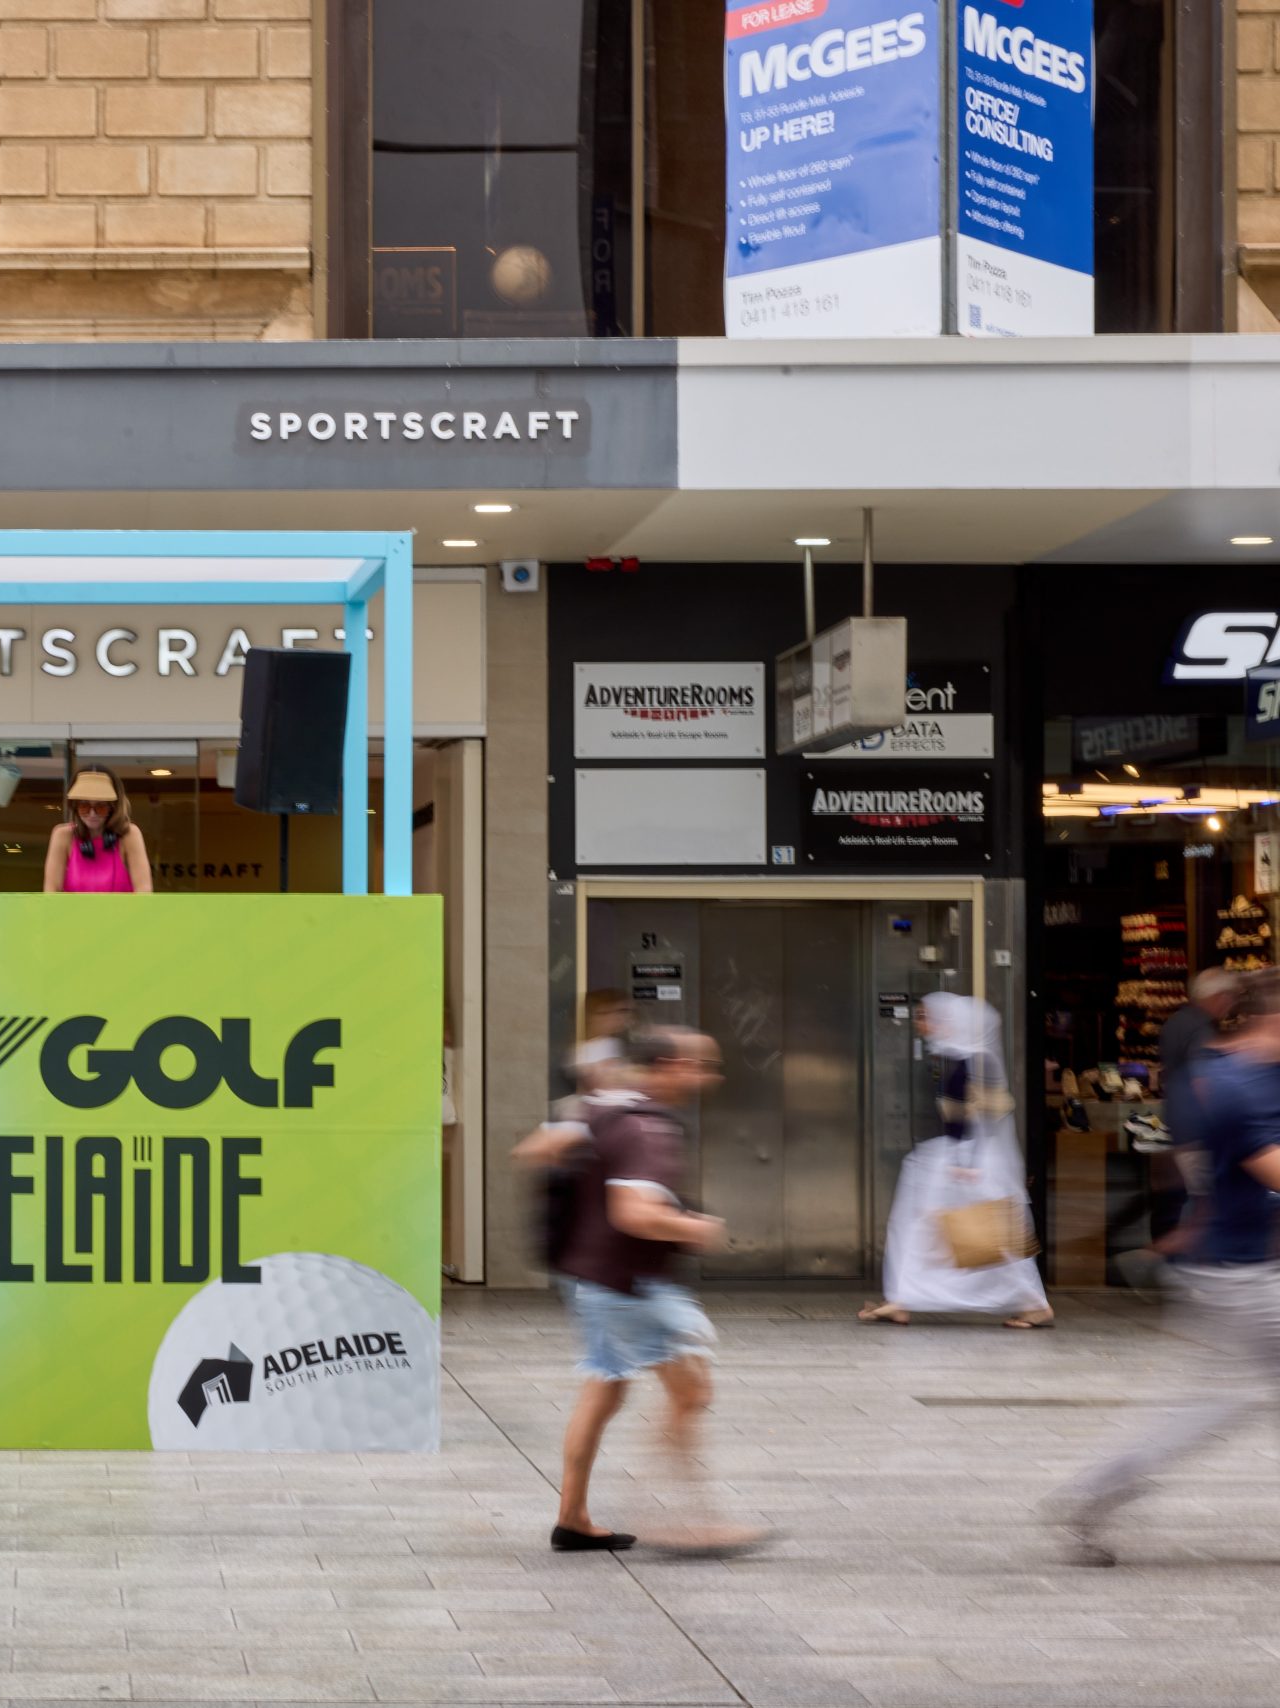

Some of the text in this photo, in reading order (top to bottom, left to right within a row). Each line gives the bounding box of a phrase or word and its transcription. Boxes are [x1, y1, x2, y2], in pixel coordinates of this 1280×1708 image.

[741, 0, 815, 29] FOR LEASE
[965, 86, 1020, 126] OFFICE/
[740, 110, 835, 152] UP HERE!
[965, 110, 1054, 162] CONSULTING
[747, 172, 776, 188] Whole
[776, 169, 797, 182] floor
[798, 165, 809, 178] of
[747, 193, 768, 208] Fully
[787, 178, 832, 198] contained
[748, 211, 775, 226] Direct
[788, 202, 821, 217] access
[740, 289, 763, 305] Tim
[740, 305, 776, 327] 0411
[250, 411, 579, 440] SPORTSCRAFT
[1173, 612, 1280, 679] S
[1256, 679, 1280, 724] S
[890, 721, 943, 738] DATA
[890, 738, 946, 752] EFFECTS
[839, 835, 874, 846] Adelaide's
[907, 835, 932, 847] Escape
[933, 835, 958, 846] Rooms
[151, 863, 263, 878] TSCRAFT
[641, 932, 657, 950] 51
[40, 1015, 343, 1109] GOLF
[263, 1331, 408, 1380] ADELAIDE
[265, 1357, 412, 1397] SOUTH AUSTRALIA
